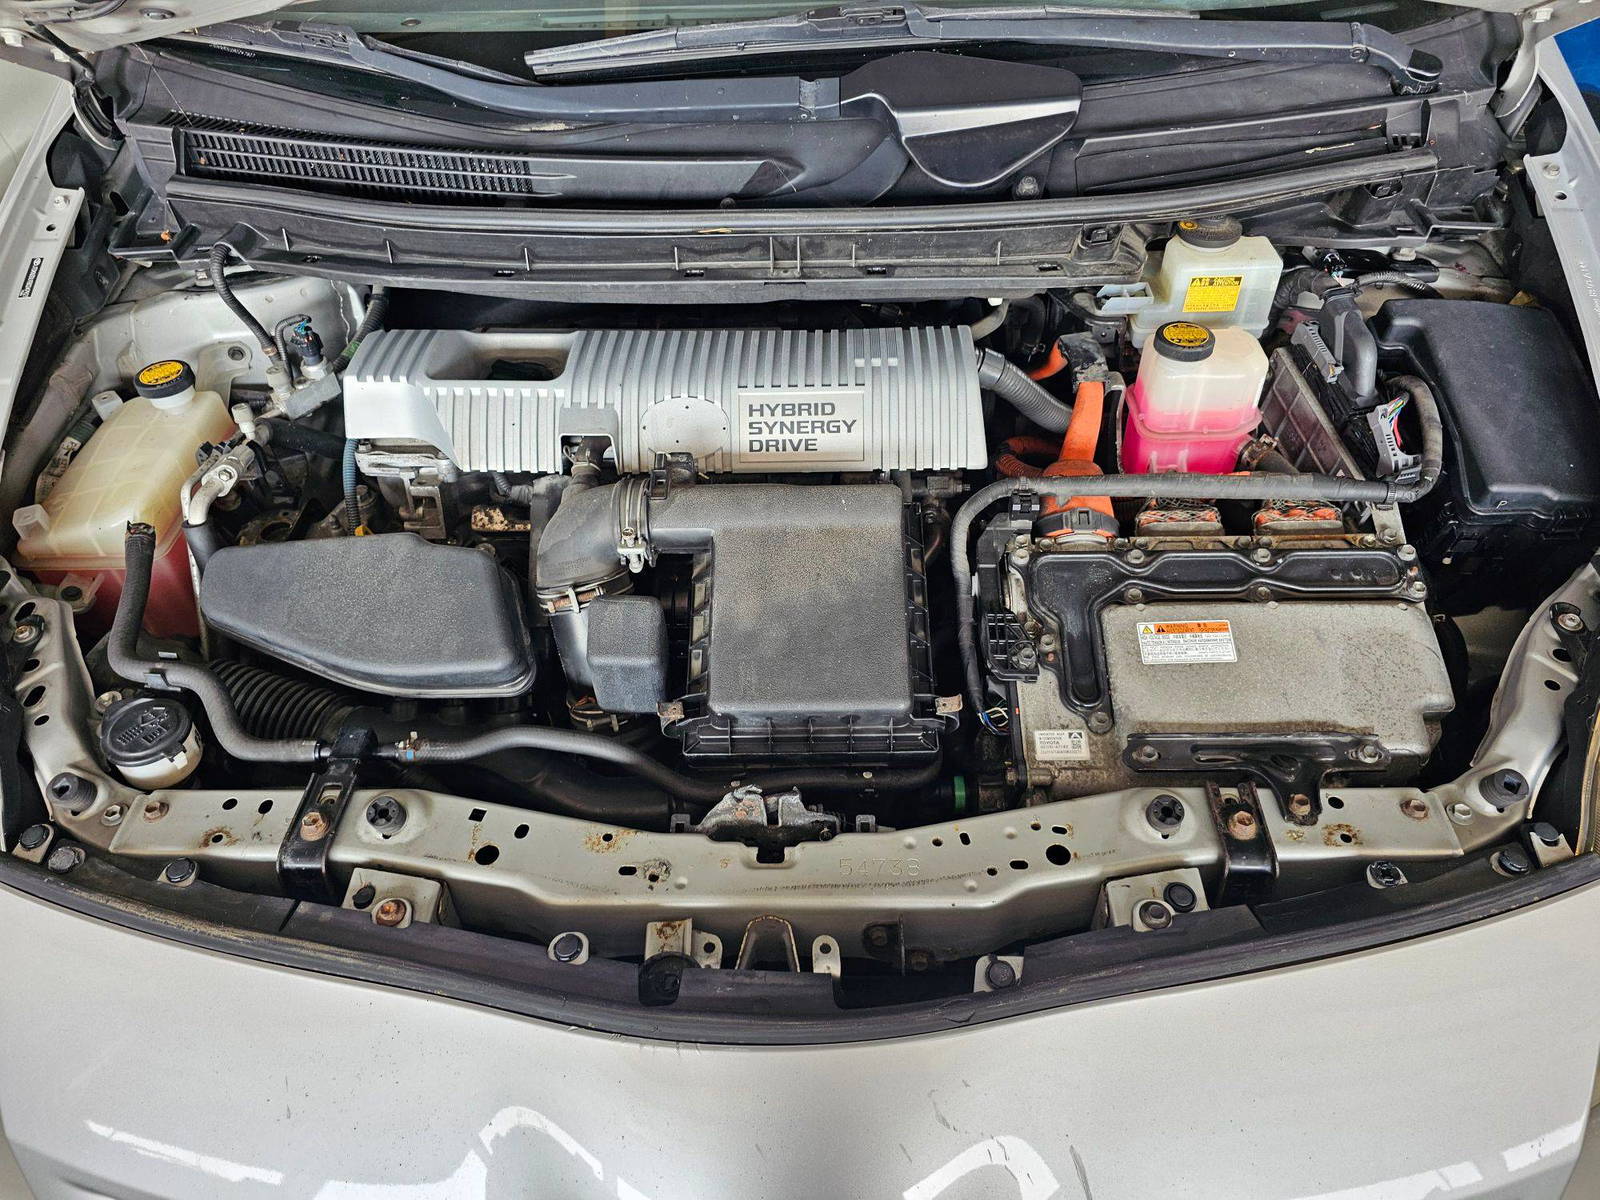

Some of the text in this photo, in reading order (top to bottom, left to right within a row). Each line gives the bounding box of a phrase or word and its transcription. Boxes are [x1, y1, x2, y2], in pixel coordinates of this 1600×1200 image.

[748, 402, 836, 417] HYBRID
[748, 419, 857, 435] SYNERGY
[748, 438, 818, 453] DRIVE
